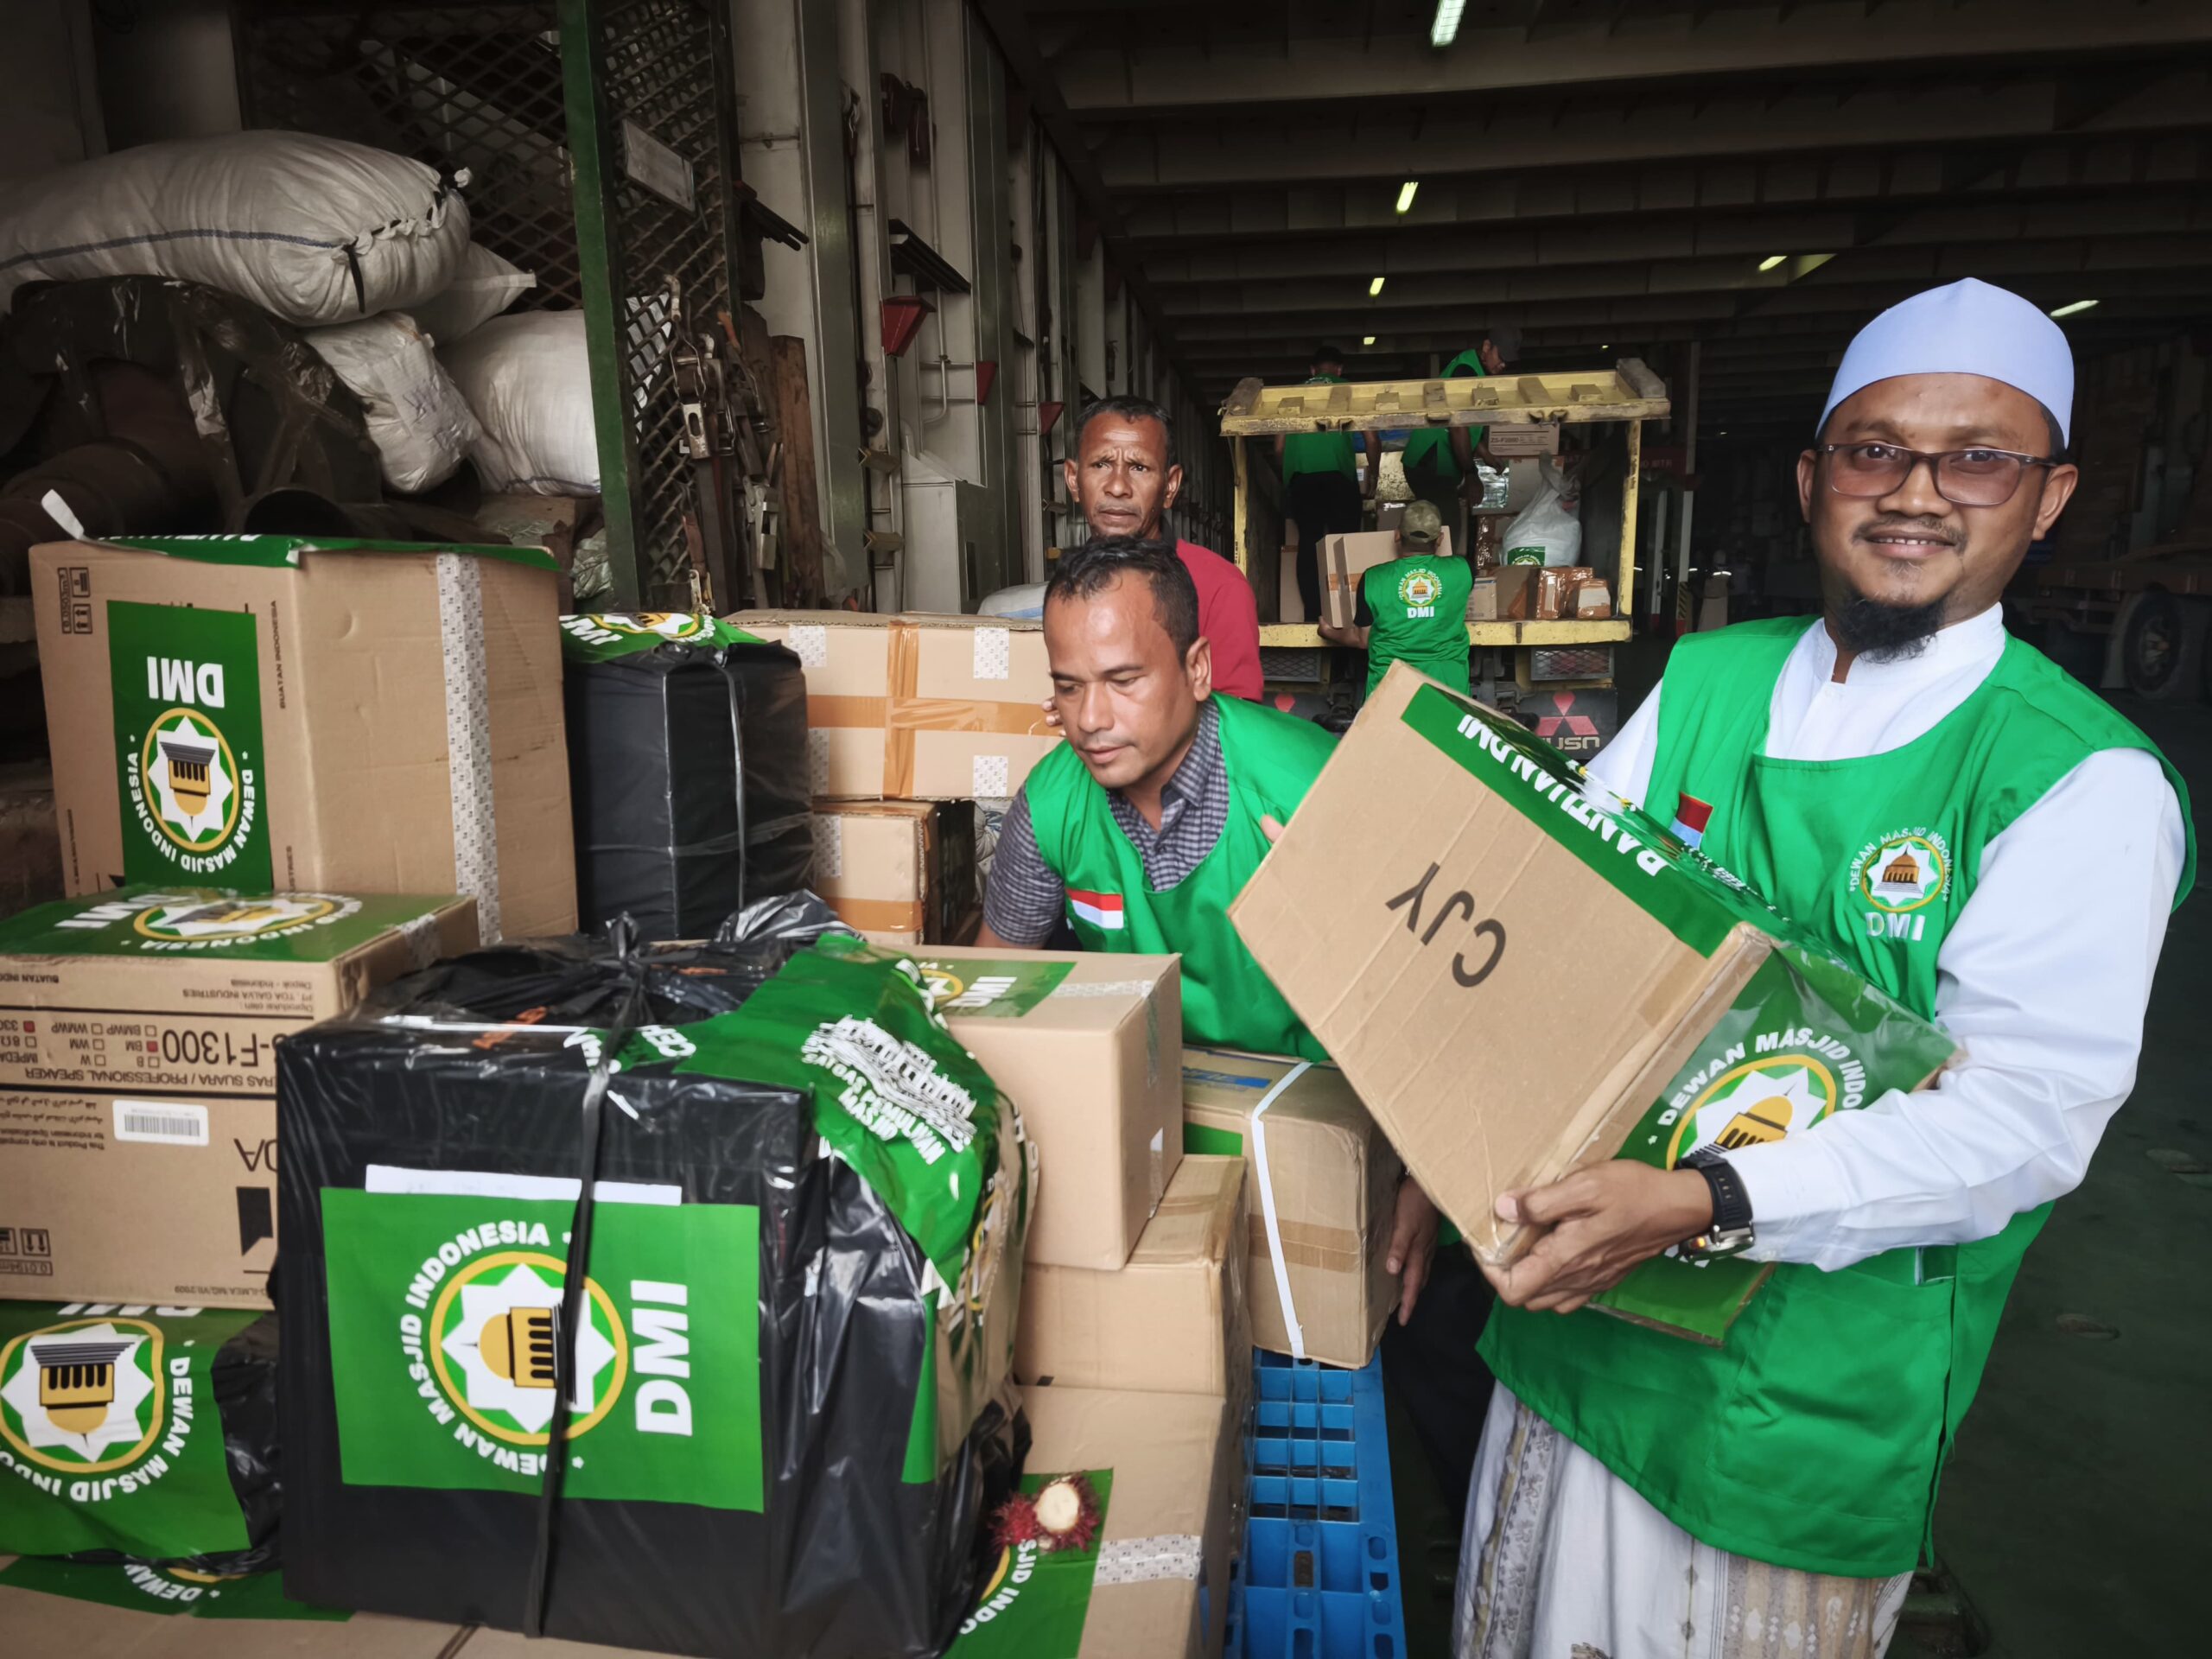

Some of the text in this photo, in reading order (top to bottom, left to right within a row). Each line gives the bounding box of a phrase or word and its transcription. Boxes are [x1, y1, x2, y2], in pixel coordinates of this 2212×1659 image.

[558, 614, 624, 645] MI
[1407, 606, 1434, 619] DMI
[143, 655, 226, 709] DMI
[1457, 714, 1521, 764] DMI
[127, 752, 177, 862] INDONESIA
[234, 769, 255, 849] DEWAN
[180, 843, 238, 873] MASJID
[1849, 842, 1877, 886] DEWAN
[1385, 861, 1506, 988] CJY
[1865, 912, 1926, 942] DMI
[22, 974, 60, 984] BUATAN
[182, 988, 239, 999] INDUSTRIES
[951, 976, 1018, 1008] DMI
[51, 1022, 87, 1034] WMWP
[106, 1024, 141, 1036] BMWP
[69, 1039, 91, 1050] WM
[124, 1040, 143, 1052] BM
[24, 1067, 85, 1081] SPEAKER
[80, 1055, 91, 1065] W
[137, 1056, 144, 1067] B
[87, 1070, 188, 1084] PROFESSIONAL
[198, 1073, 244, 1085] SUARA
[1657, 1027, 1866, 1127] DEWAN MASJID INDO
[837, 1086, 899, 1141] MASJID
[404, 1219, 550, 1310] INDONESIA
[400, 1313, 456, 1426] MASJID
[630, 1279, 693, 1437] DMI
[162, 1357, 194, 1458] DEWAN
[69, 1453, 170, 1503] MASJID
[1010, 1538, 1038, 1586] SJID
